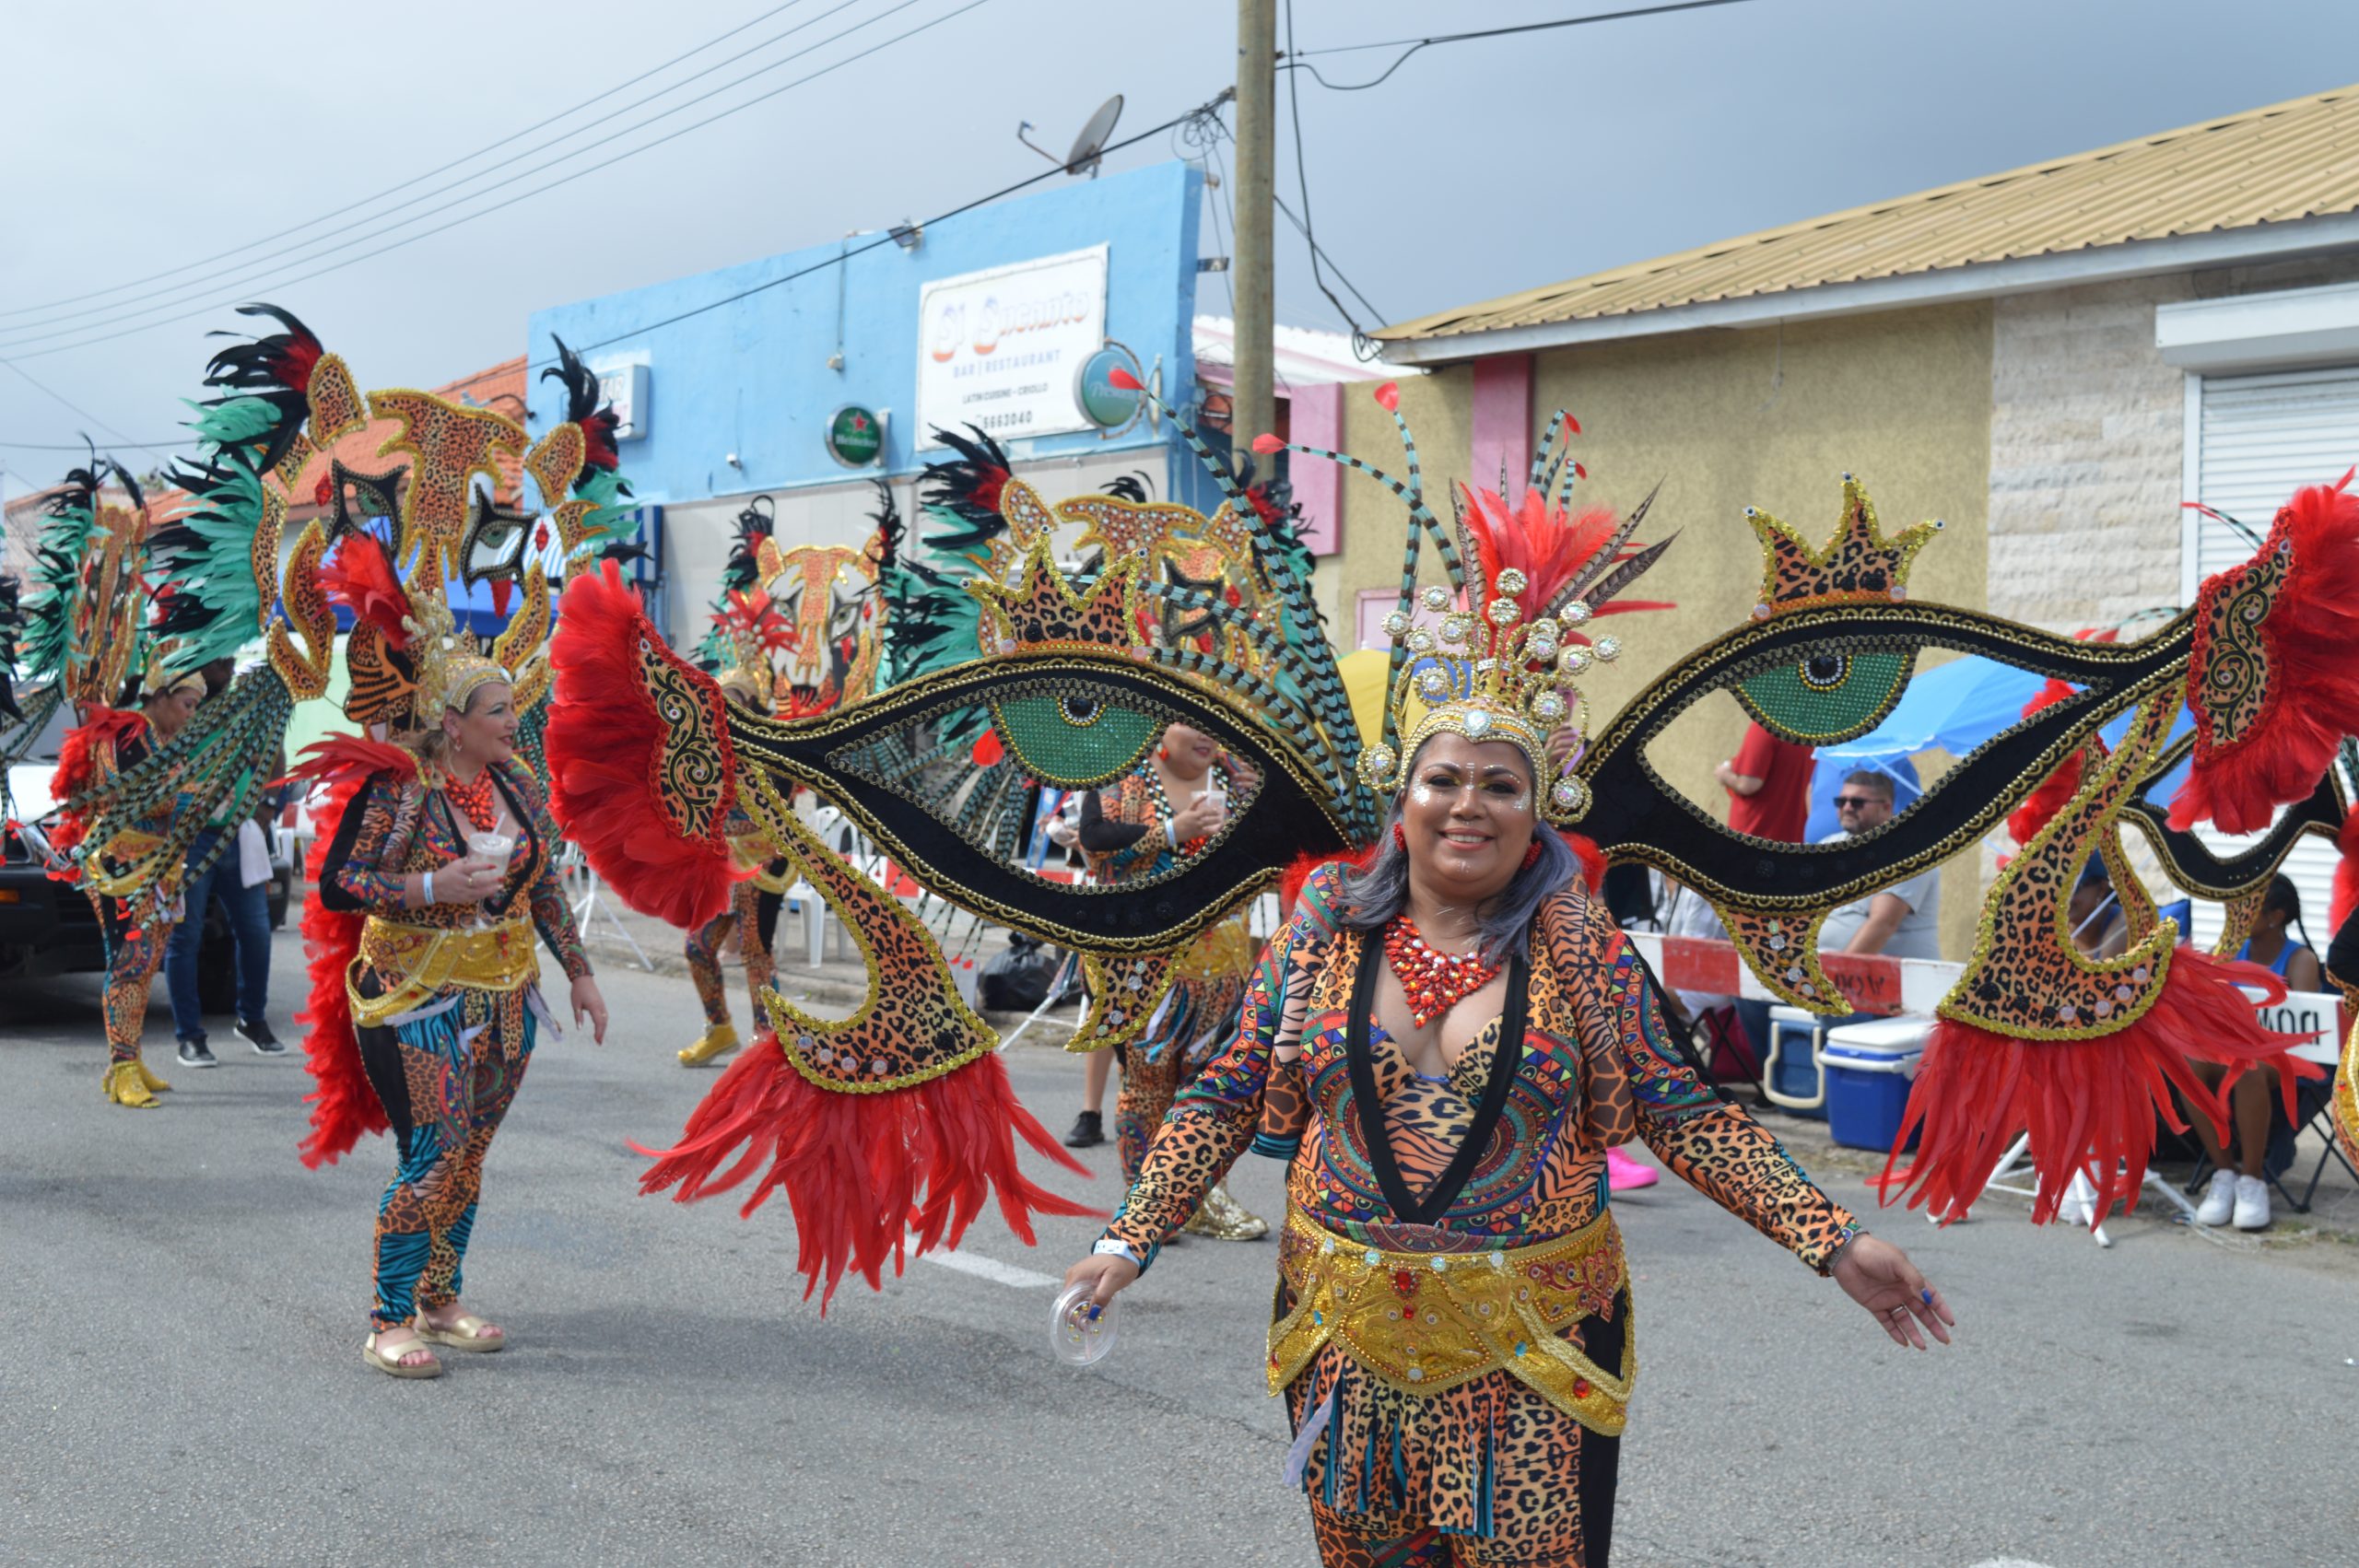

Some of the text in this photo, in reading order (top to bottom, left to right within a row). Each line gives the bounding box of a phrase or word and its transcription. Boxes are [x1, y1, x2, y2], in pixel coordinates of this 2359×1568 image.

[953, 363, 975, 379] BAR
[985, 349, 1061, 373] RESTAURANT
[962, 390, 982, 404] LATIN
[982, 387, 1012, 401] CUISINE
[1017, 381, 1050, 396] CRIOLLO
